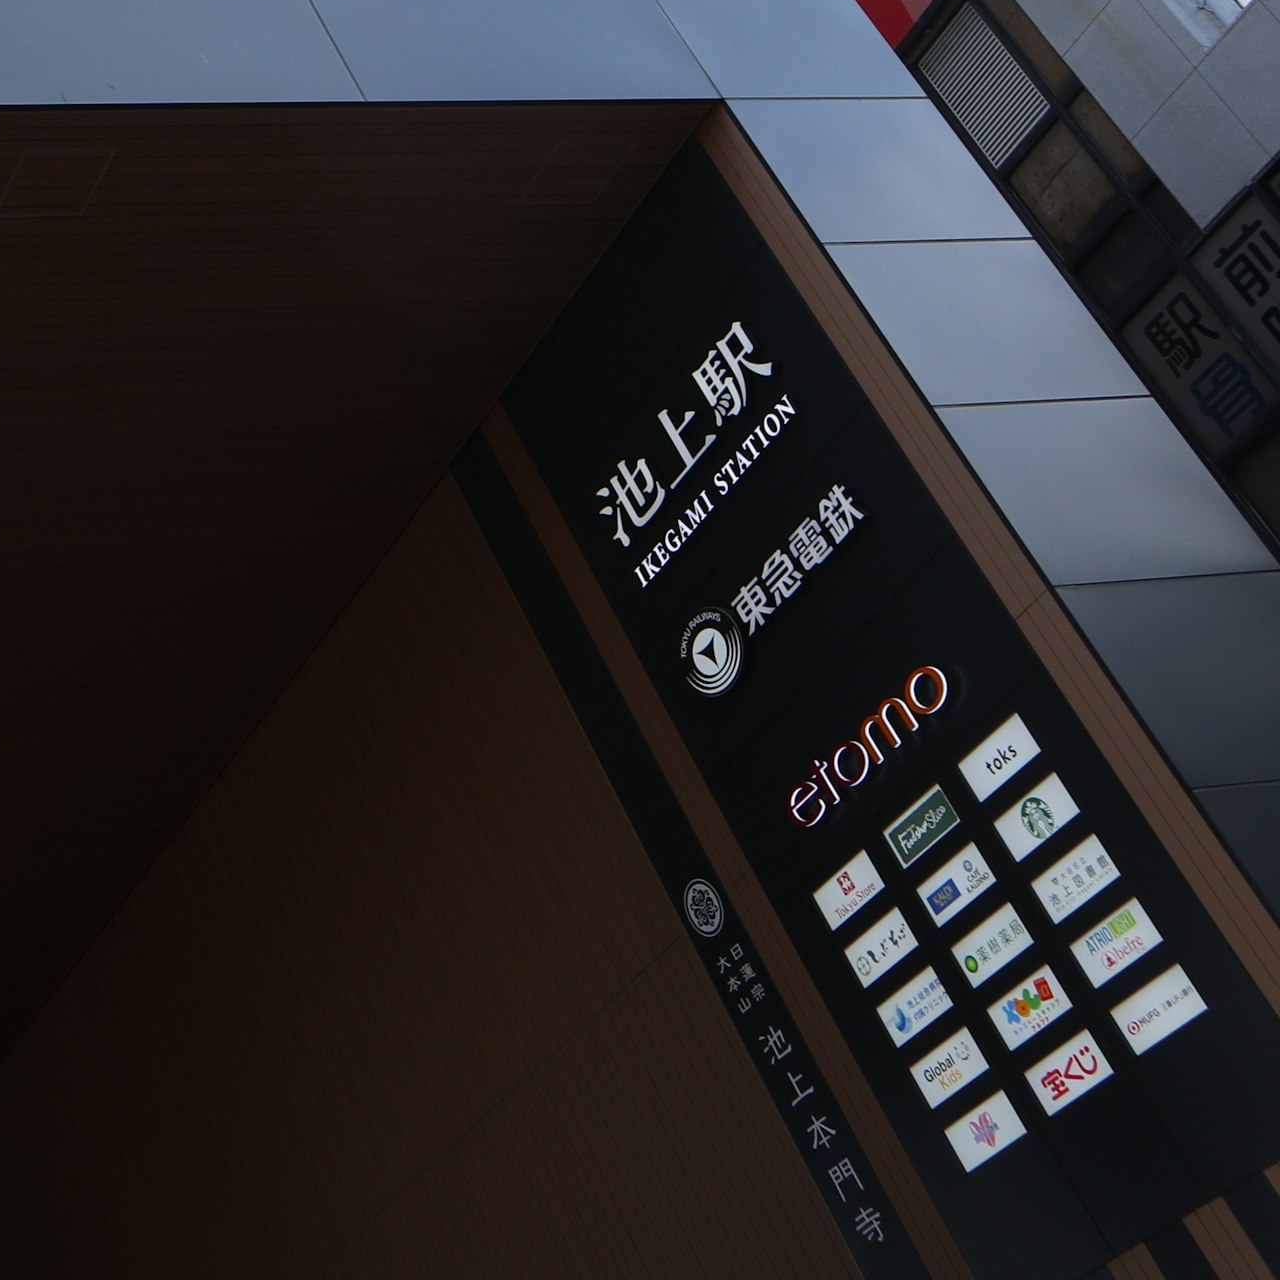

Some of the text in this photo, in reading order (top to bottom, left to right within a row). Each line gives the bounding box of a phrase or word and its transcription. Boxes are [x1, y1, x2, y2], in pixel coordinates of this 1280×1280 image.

[596, 321, 772, 547] 池上駅
[634, 394, 797, 588] IKEGAMI STATION
[731, 484, 864, 636] 東急電鉄
[680, 611, 721, 659] TOKYU RAILWAYS
[788, 665, 948, 827] etomo
[986, 744, 1017, 775] toks
[834, 882, 877, 919] Tokyu Store
[933, 885, 954, 905] KALDI
[966, 872, 990, 894] KALDINO
[1048, 855, 1109, 908] 池上図書館
[975, 919, 1025, 965] 薬樹薬局
[1085, 926, 1114, 956] ATRIO
[1114, 935, 1144, 961] befre
[716, 955, 752, 1014] 大本山
[729, 943, 766, 1002] 日蓮宗
[1139, 1008, 1161, 1028] MUFG
[923, 1053, 955, 1083] Global
[939, 1069, 963, 1091] Kids
[1040, 1045, 1099, 1101] 宝くじ
[758, 1025, 885, 1243] 池上本門寺
